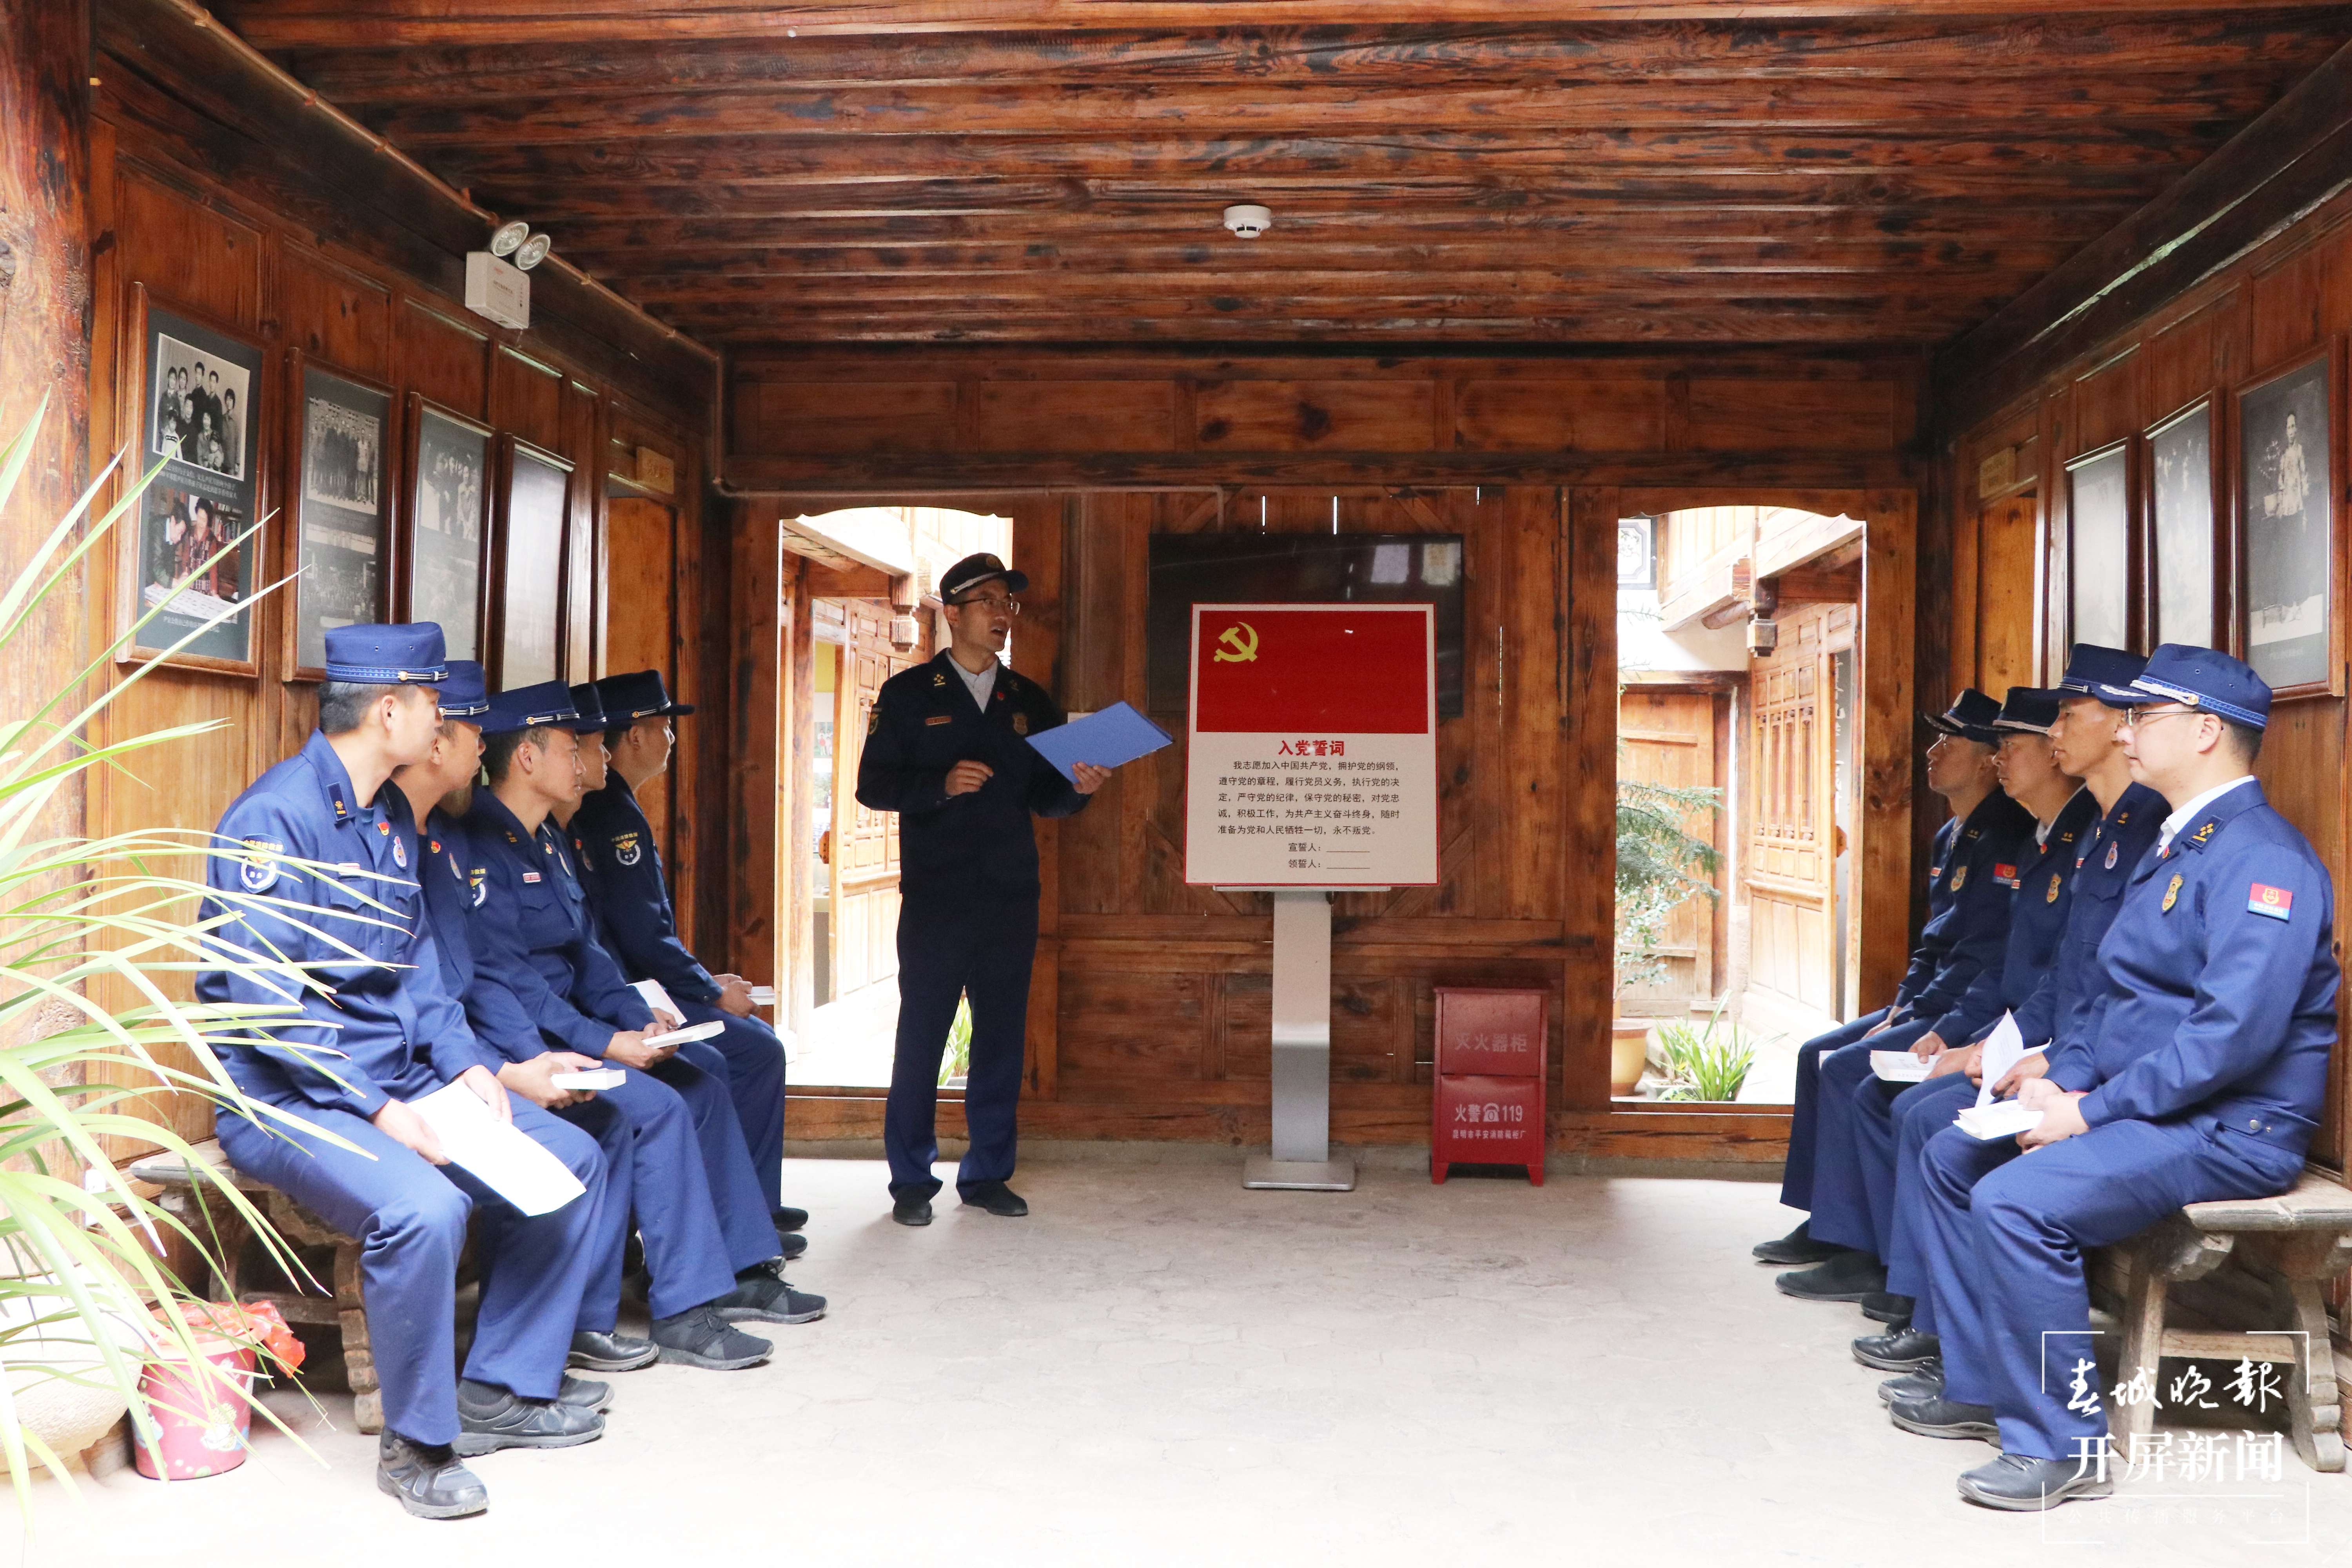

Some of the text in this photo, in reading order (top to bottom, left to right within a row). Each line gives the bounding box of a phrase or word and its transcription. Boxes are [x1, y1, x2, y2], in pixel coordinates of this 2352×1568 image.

[1278, 740, 1345, 756] 入党誓词
[1234, 761, 1398, 771] 我志愿加入中国共产党，拥护党的纲领，
[1219, 777, 1399, 786] 遵守党的章程，履行党员义务，执行党的决
[1219, 793, 1399, 802] 定，严守党的纪律，保守党的秘密，对党忠
[1218, 809, 1399, 819] 诚，积极工作，为共产主义奋斗终身，随时
[1218, 826, 1376, 835] 准备为党和人民牺牲一切，永不叛党。
[1289, 843, 1321, 852] 宣誓人：
[1289, 859, 1321, 868] 领誓人：
[1455, 1032, 1527, 1053] 灭火器柜
[1455, 1104, 1523, 1123] 火警 119
